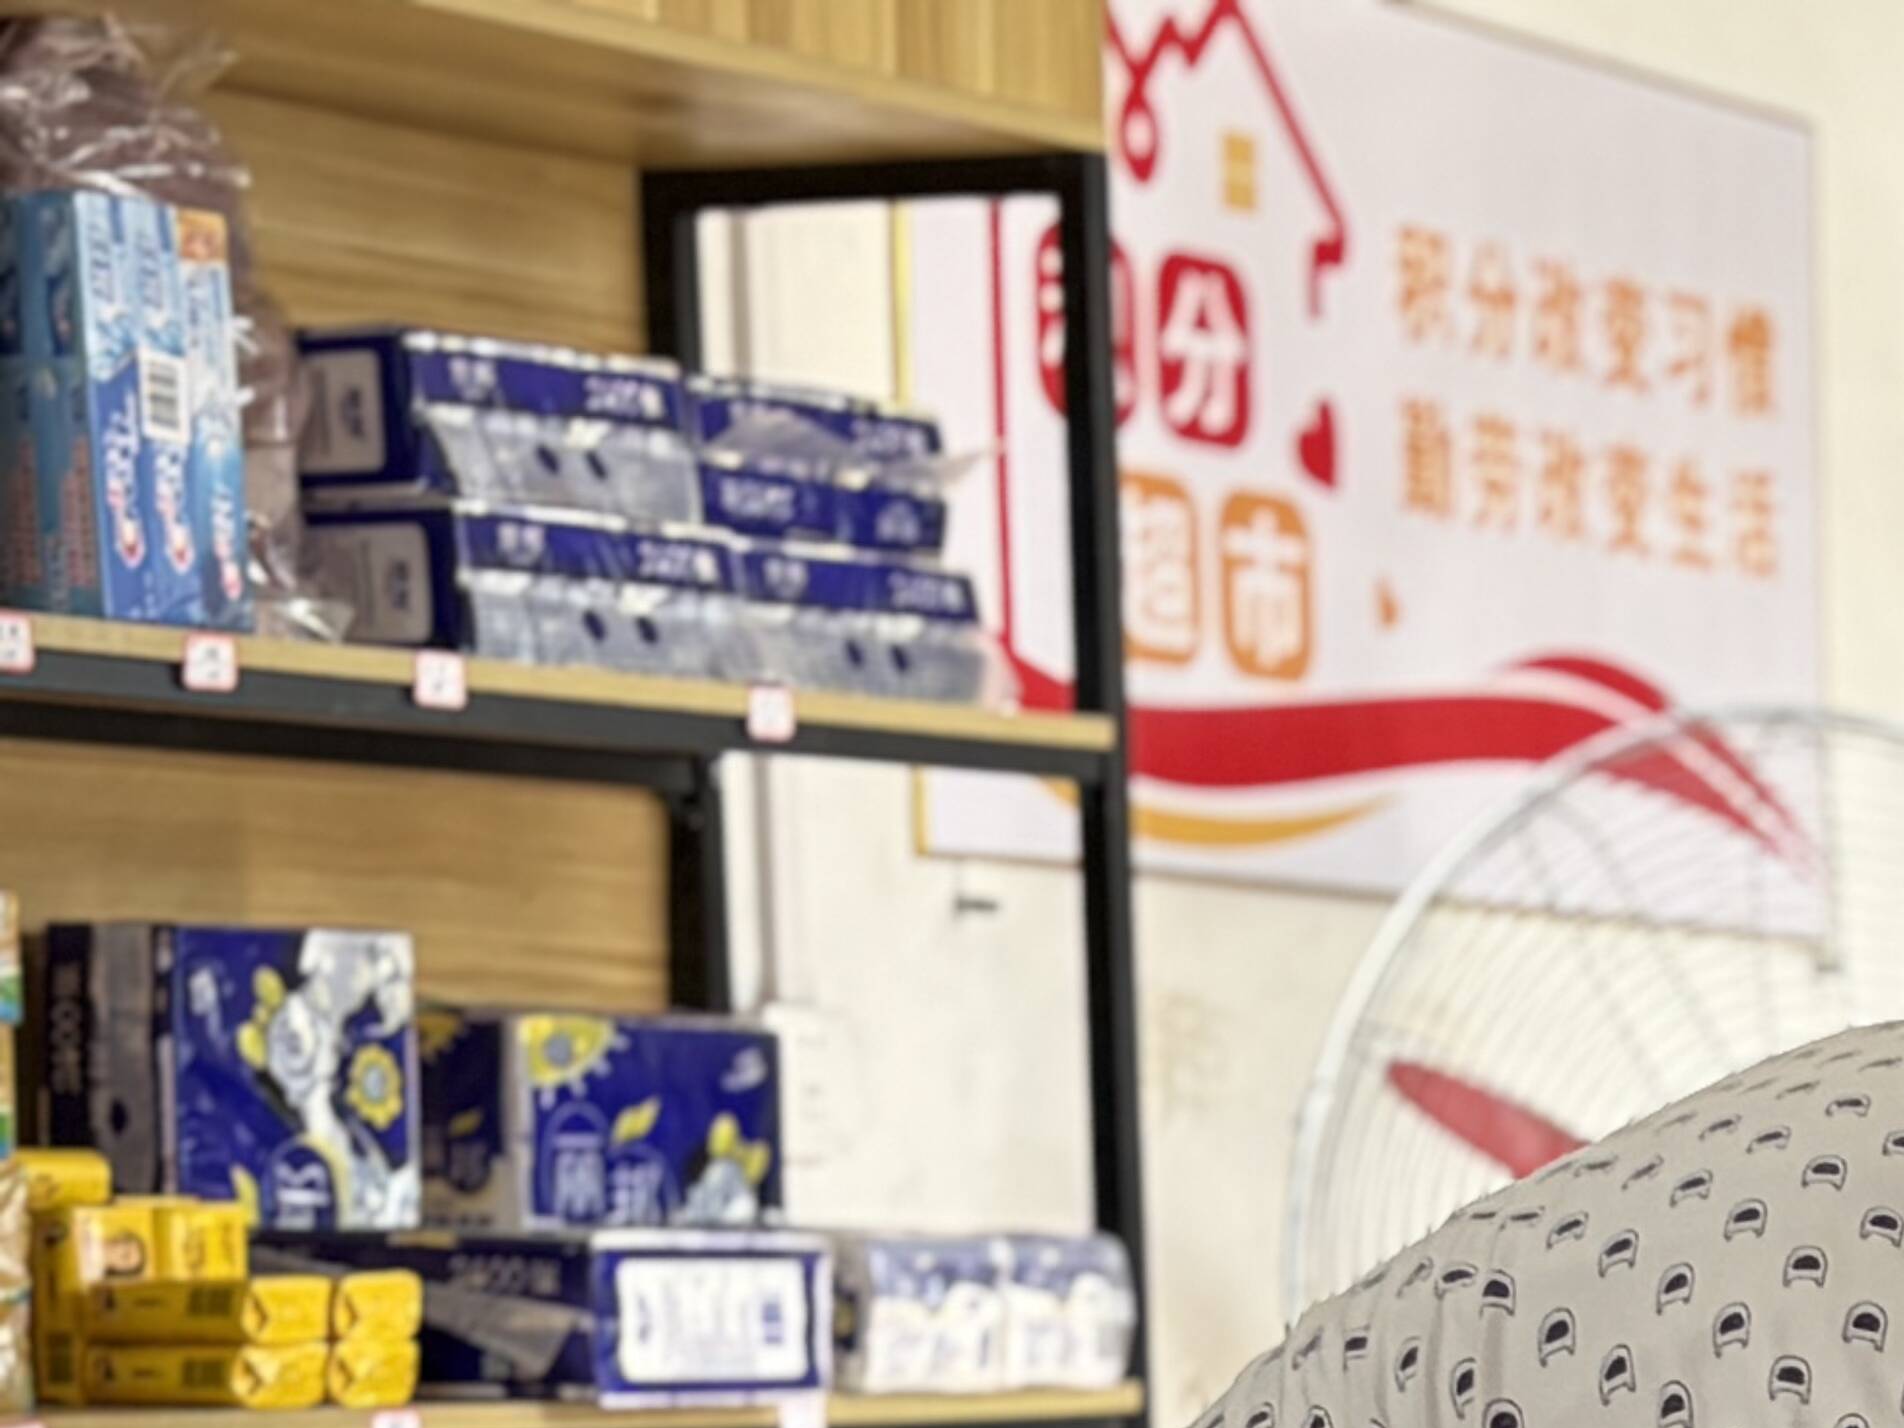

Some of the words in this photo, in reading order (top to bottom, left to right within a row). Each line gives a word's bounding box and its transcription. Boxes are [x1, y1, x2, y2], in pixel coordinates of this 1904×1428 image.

[1397, 224, 1776, 416] 积分改变习惯
